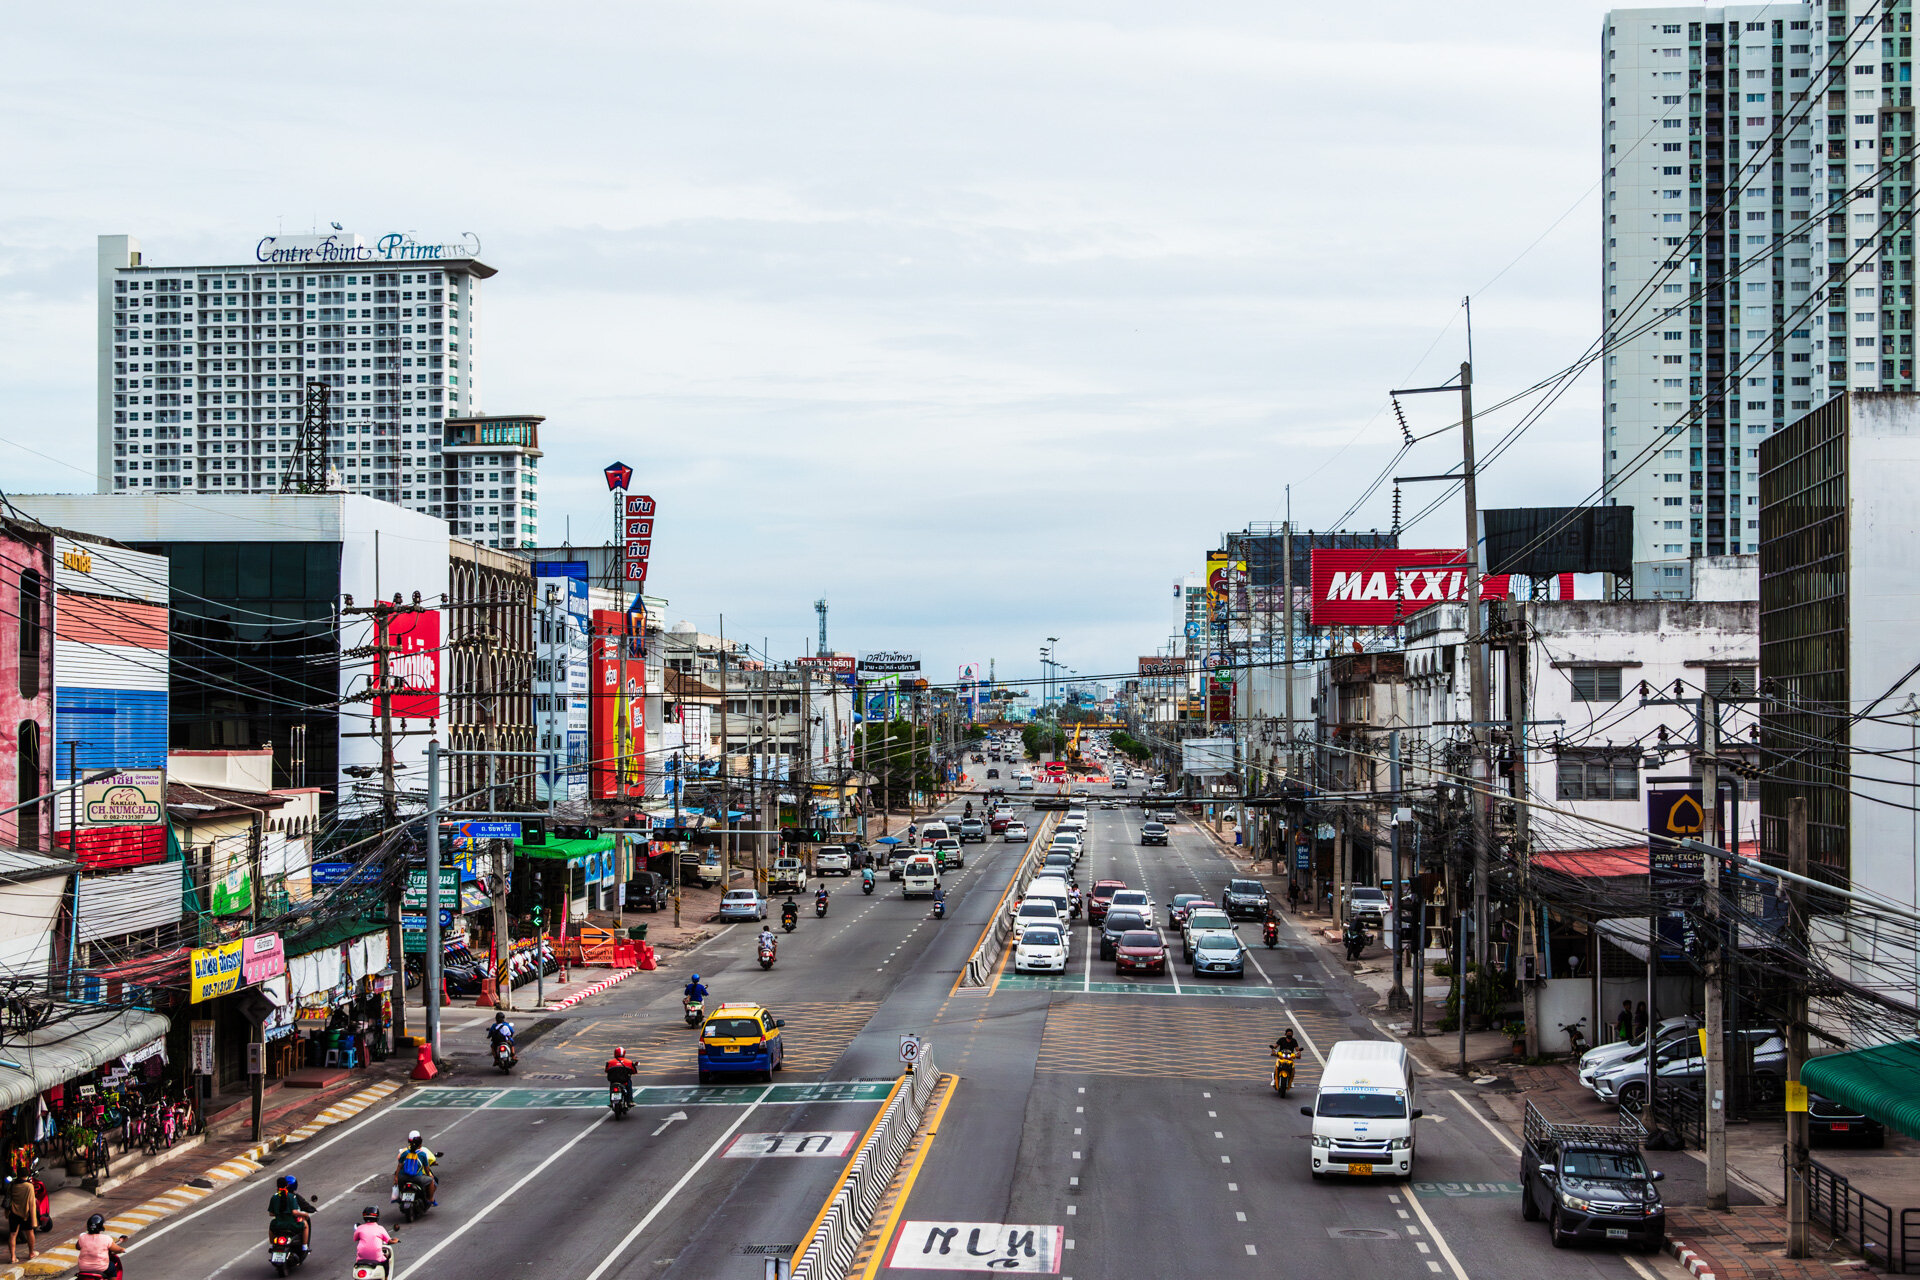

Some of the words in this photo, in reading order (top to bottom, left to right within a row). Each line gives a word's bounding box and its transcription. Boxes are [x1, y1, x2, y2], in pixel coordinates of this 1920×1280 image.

[256, 236, 313, 263] Centre
[316, 235, 371, 262] Point
[377, 233, 442, 260] Prime
[628, 498, 652, 513] เงิน
[629, 523, 649, 535] สด
[628, 543, 649, 557] ทัน
[629, 563, 644, 579] ใจ
[91, 805, 157, 815] CH.NUMCHAI
[1655, 853, 1674, 862] ATM
[1413, 1182, 1525, 1198] าเกลือ
[922, 1227, 1036, 1268] ห้าม
